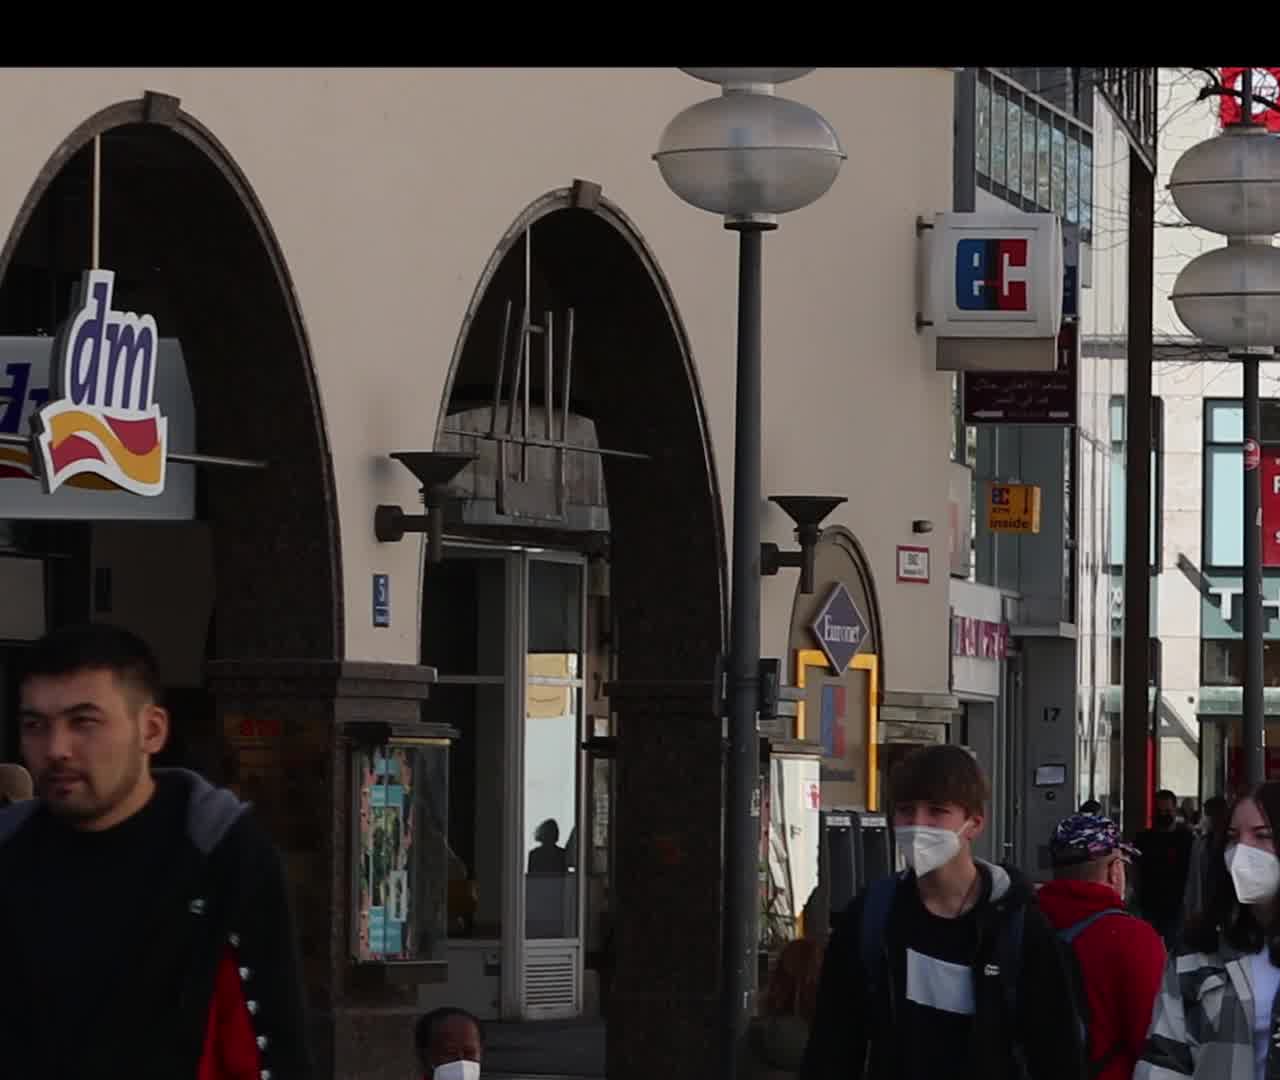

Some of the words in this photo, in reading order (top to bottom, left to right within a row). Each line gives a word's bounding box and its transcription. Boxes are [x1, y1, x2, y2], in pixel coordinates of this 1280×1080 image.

[71, 282, 153, 411] dm
[0, 363, 48, 433] d
[1043, 707, 1062, 722] 17
